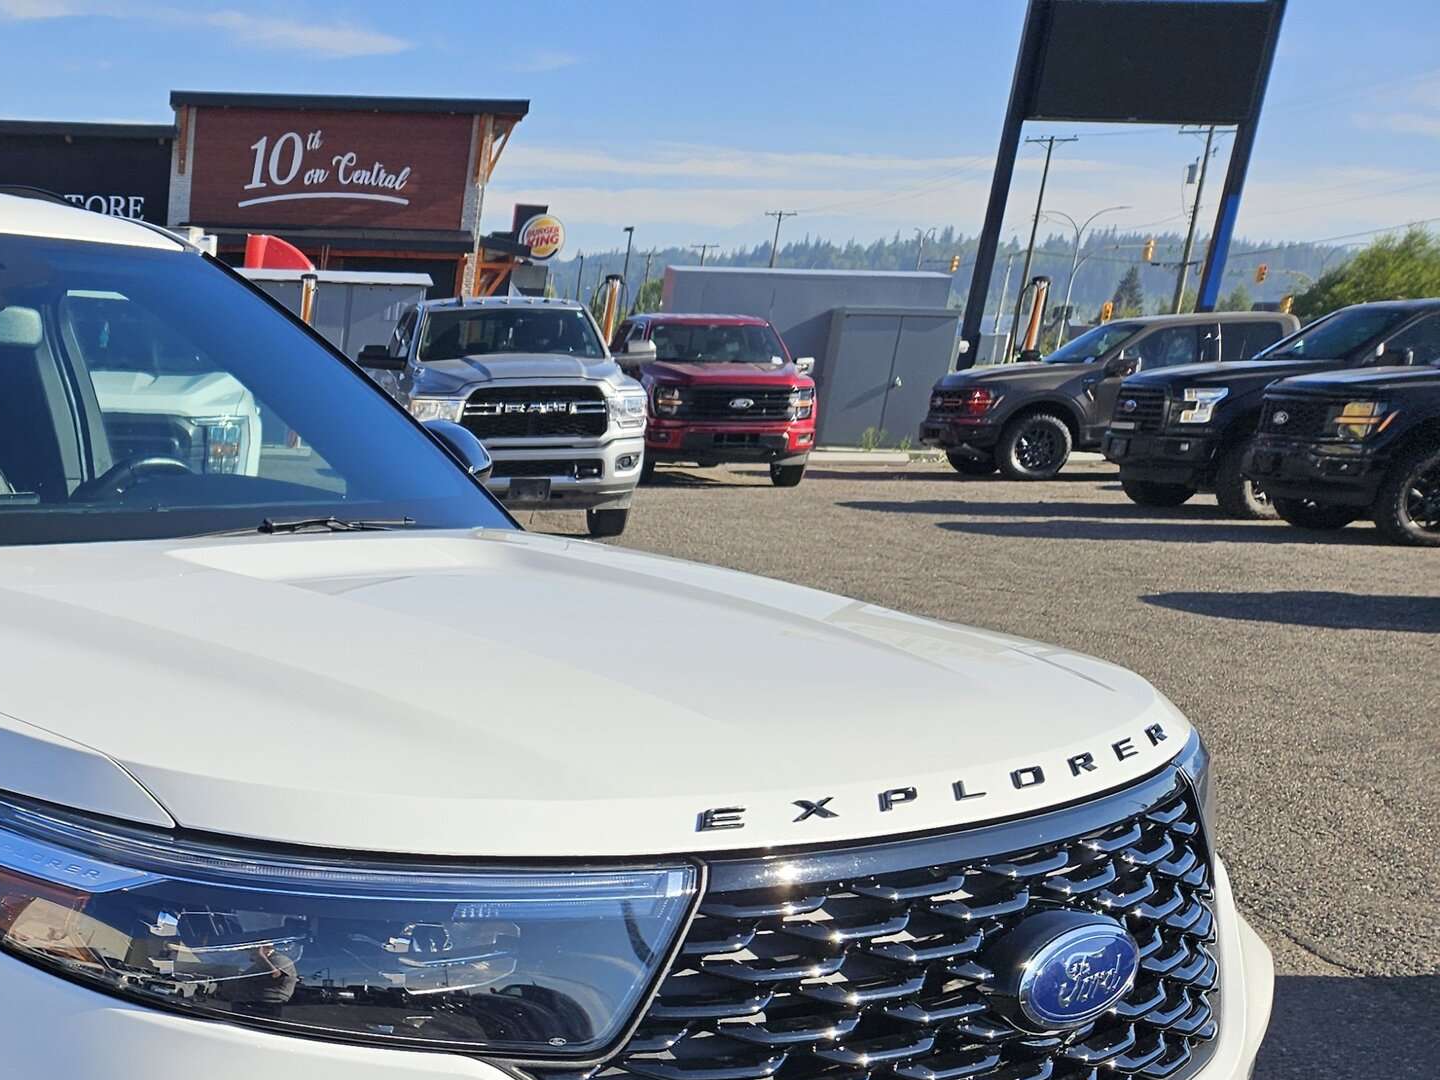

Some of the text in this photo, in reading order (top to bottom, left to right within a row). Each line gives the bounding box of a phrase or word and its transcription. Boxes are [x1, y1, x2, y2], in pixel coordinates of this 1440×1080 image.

[244, 130, 411, 191] 10th on Central
[527, 234, 560, 249] KING
[695, 721, 1167, 832] EXPLORER
[1058, 946, 1122, 1008] Ford
